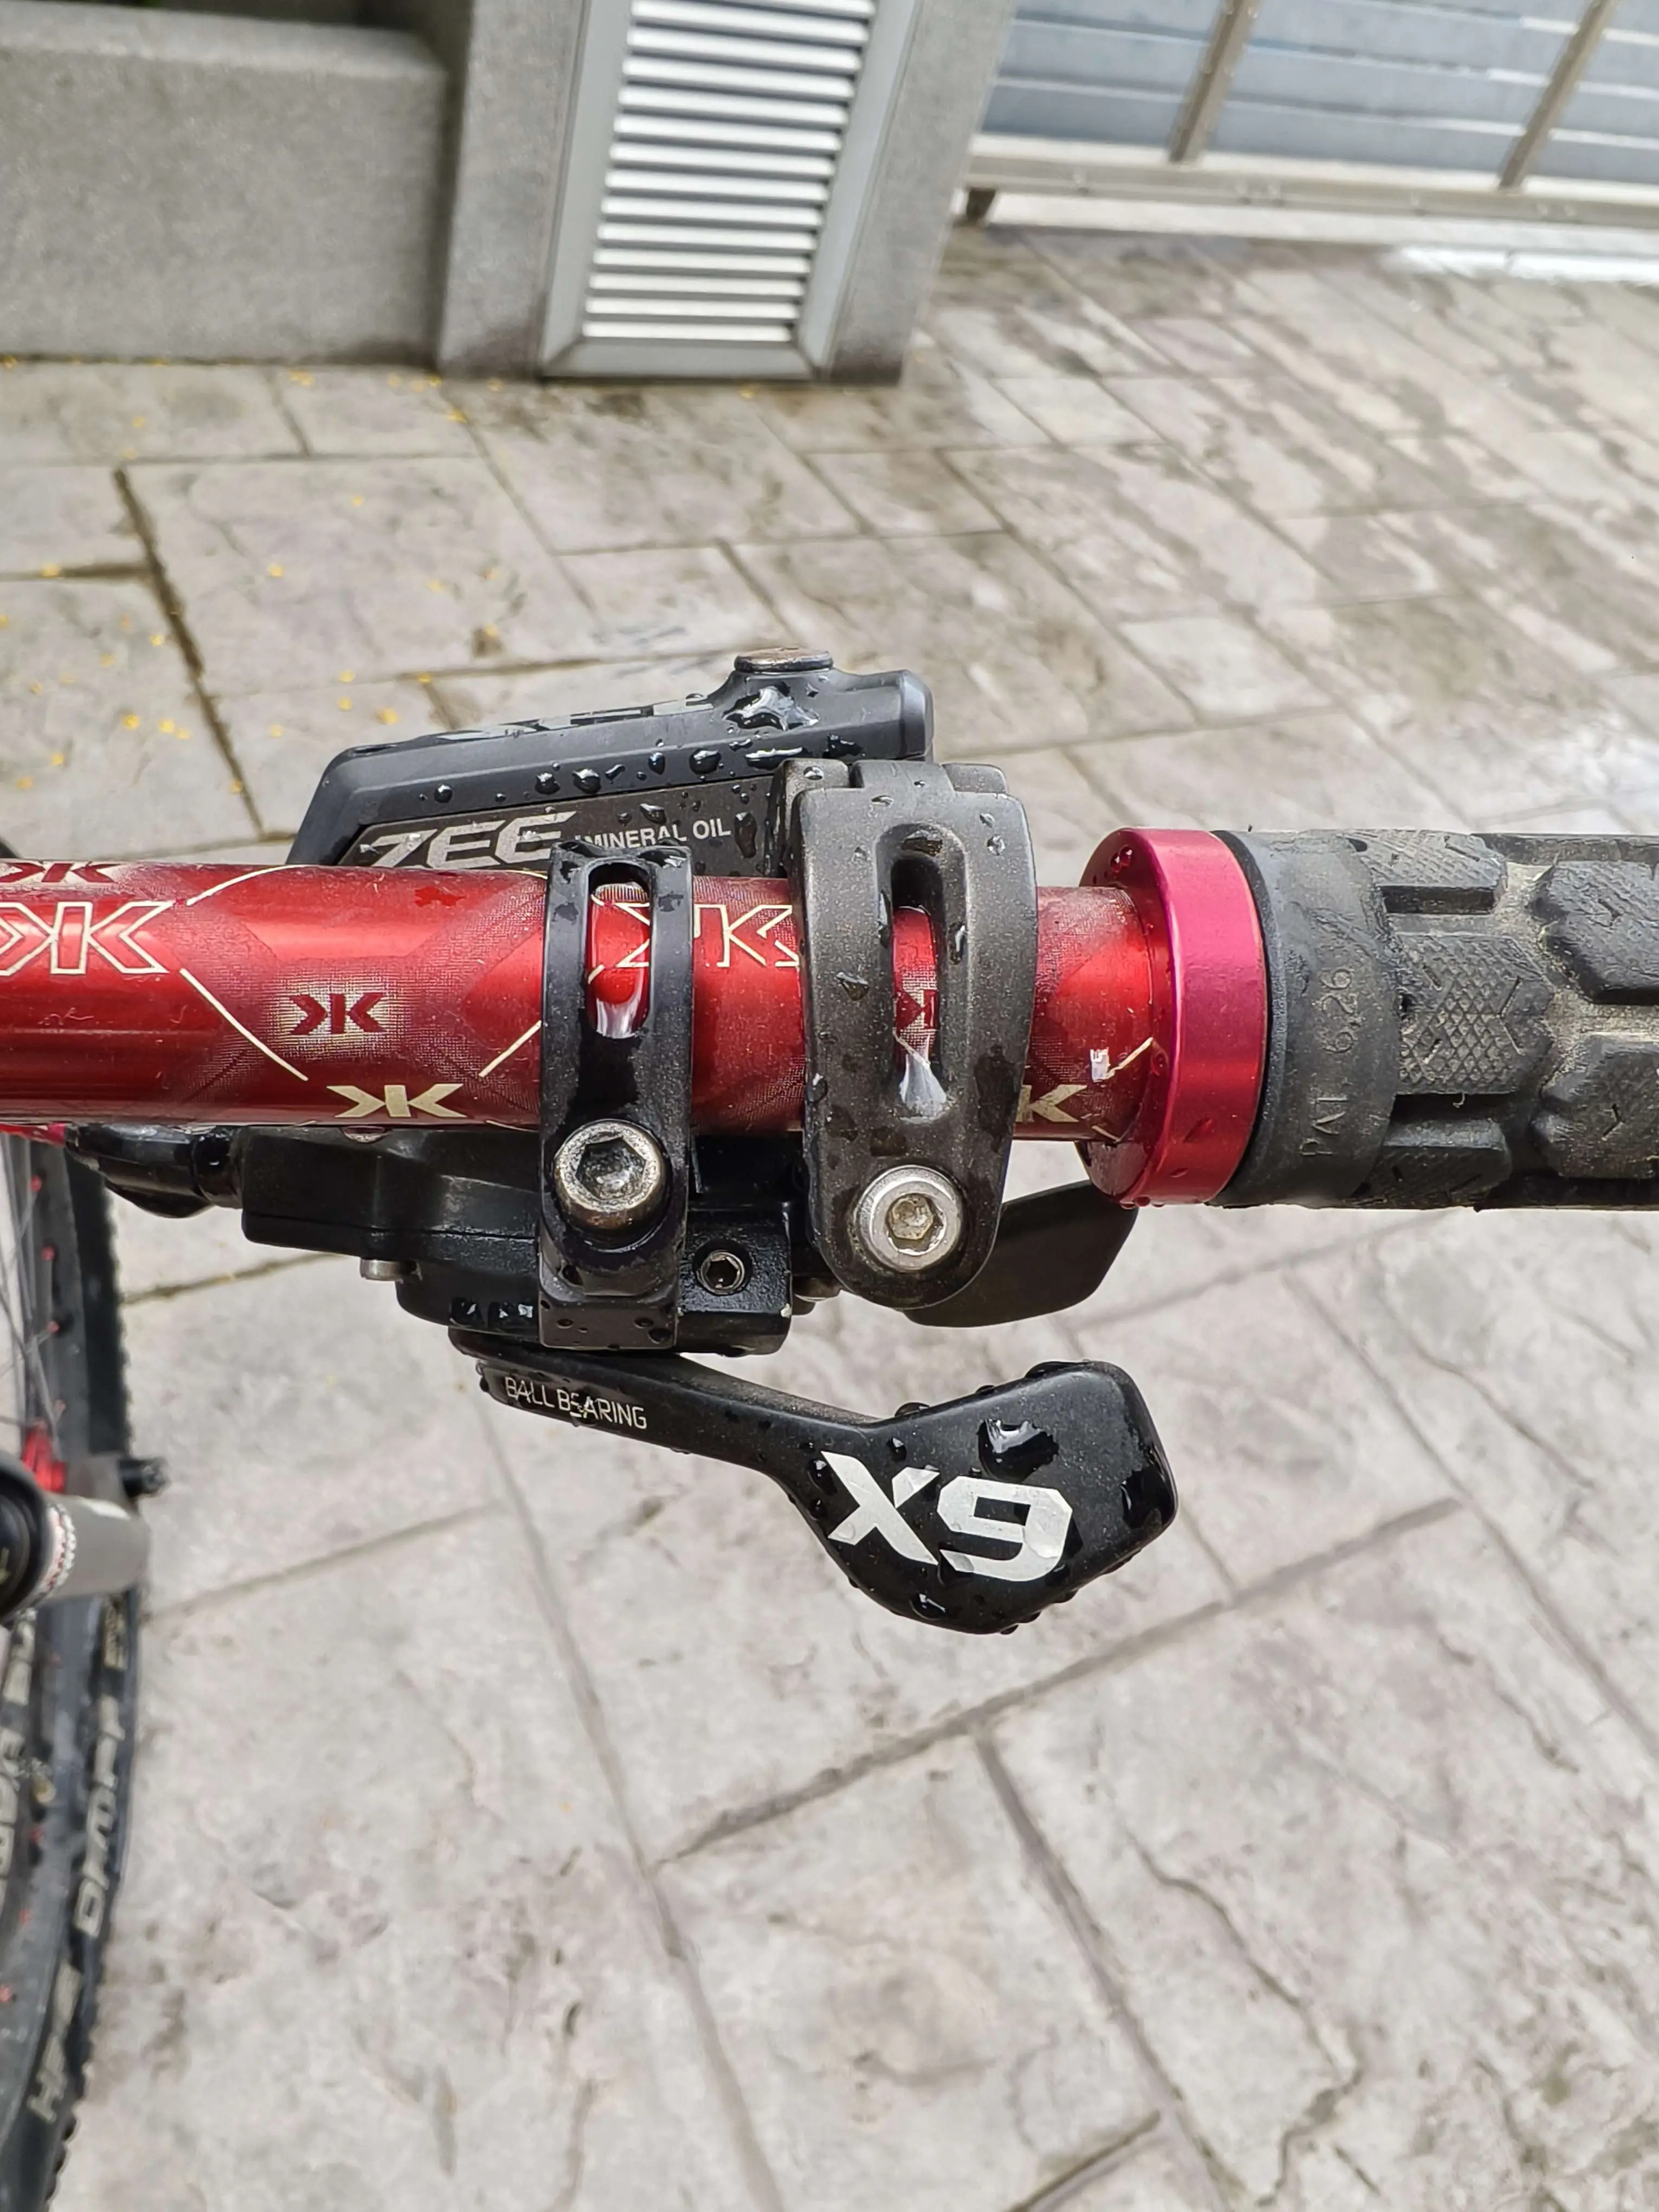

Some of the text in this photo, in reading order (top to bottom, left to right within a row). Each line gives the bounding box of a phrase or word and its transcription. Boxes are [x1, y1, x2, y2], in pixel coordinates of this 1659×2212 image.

[369, 811, 577, 870] ZEE
[584, 818, 731, 849] MINERAL OIL
[505, 1376, 647, 1429] BALL BEARING
[820, 1450, 1073, 1581] X9
